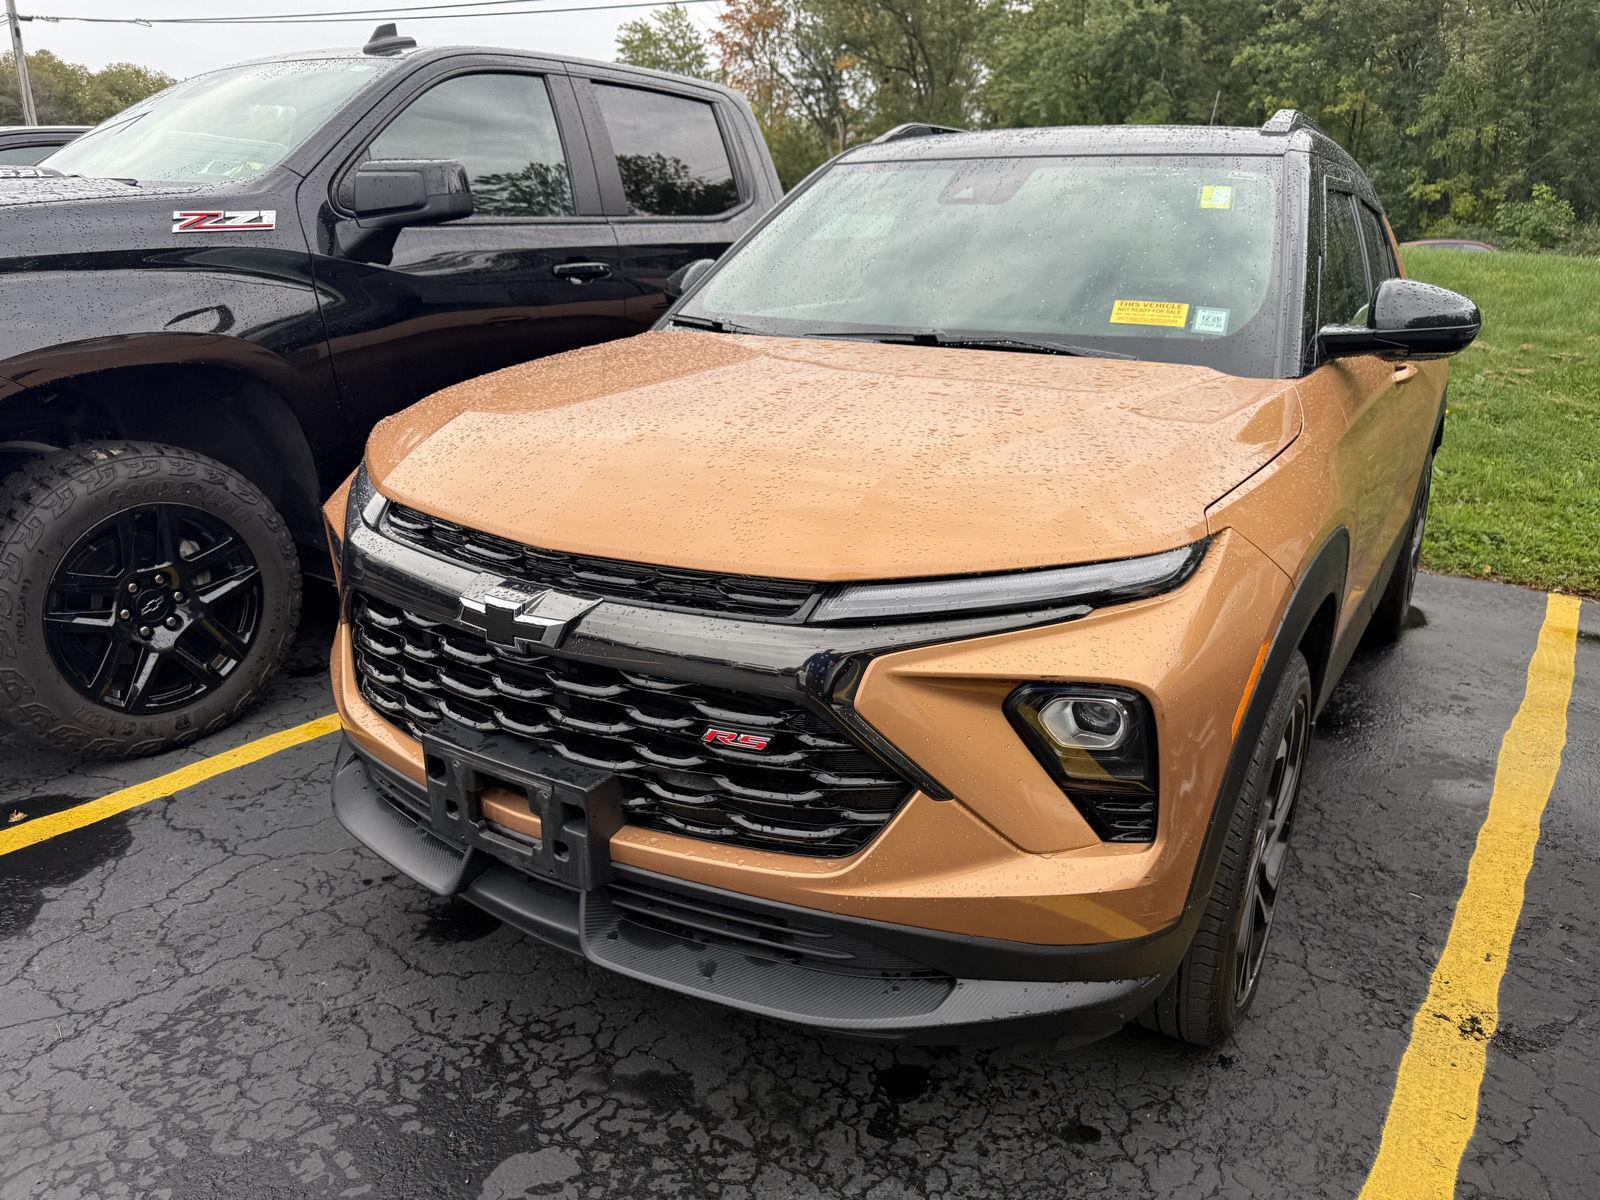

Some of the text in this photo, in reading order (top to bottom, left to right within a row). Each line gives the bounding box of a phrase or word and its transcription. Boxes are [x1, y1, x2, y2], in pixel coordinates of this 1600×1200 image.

[172, 210, 277, 233] Z71
[1143, 302, 1184, 310] VEHICLE
[107, 479, 252, 527] GOODYEAR
[701, 728, 772, 751] RS
